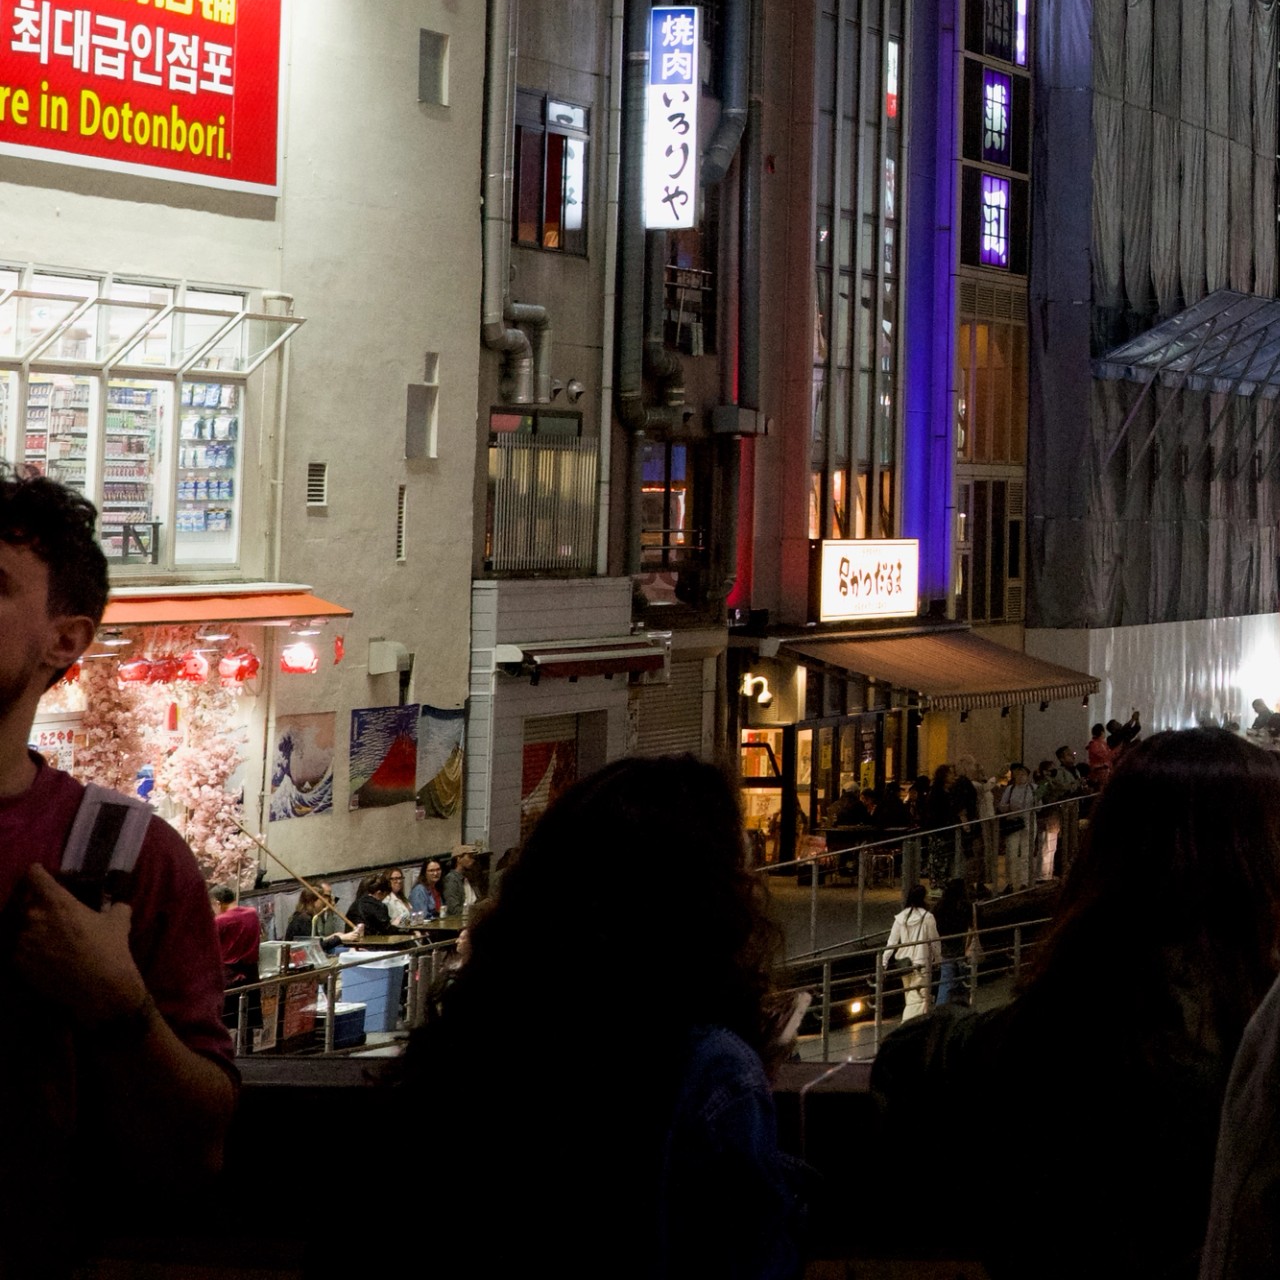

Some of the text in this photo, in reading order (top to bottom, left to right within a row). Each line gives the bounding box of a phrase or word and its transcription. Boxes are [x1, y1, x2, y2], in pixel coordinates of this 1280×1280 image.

[0, 81, 233, 161] re in Dotonbori.
[660, 12, 694, 222] 焼肉 いろりや
[39, 729, 74, 746] たこやき
